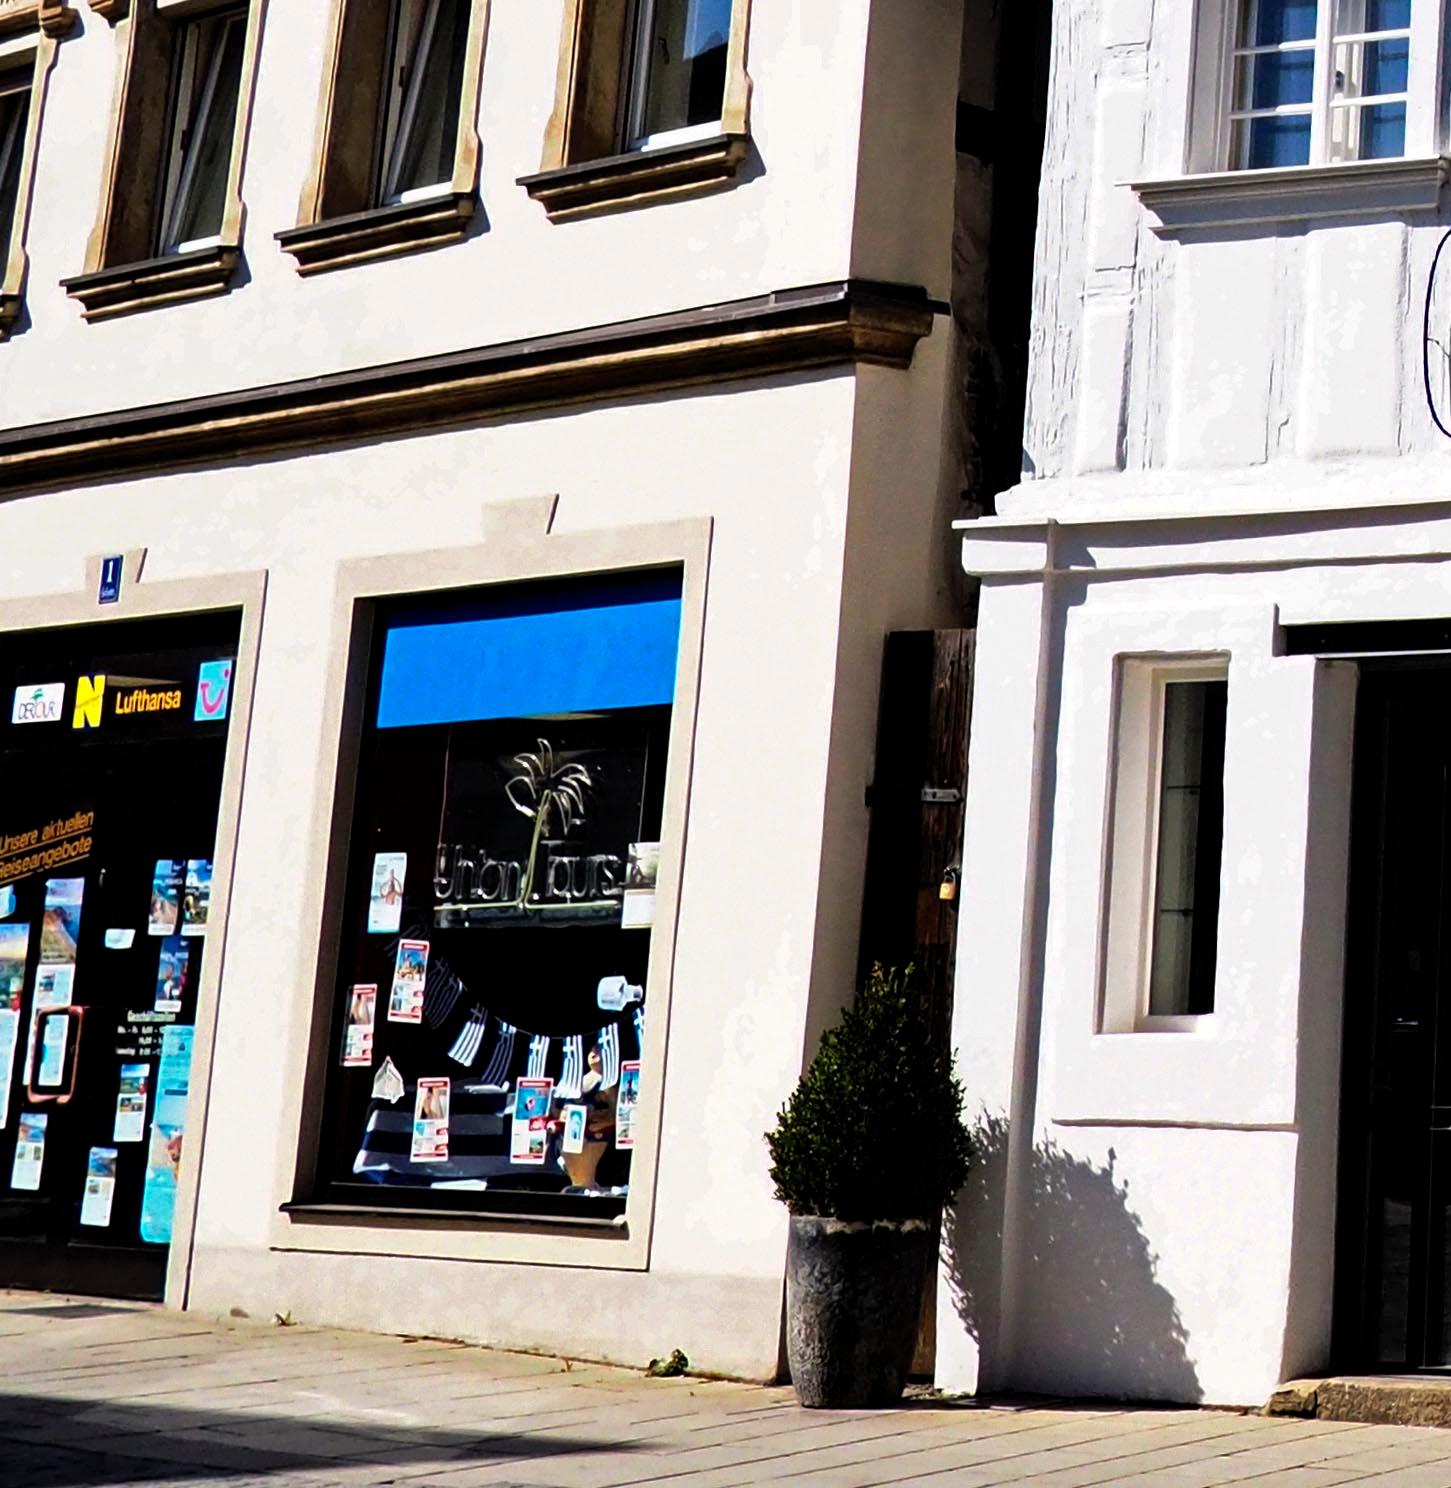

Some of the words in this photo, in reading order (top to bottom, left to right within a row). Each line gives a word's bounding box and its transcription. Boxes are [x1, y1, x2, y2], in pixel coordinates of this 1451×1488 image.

[107, 559, 114, 582] 1
[115, 689, 182, 714] Lufthansa
[0, 829, 38, 853] Unsere
[41, 811, 94, 841] aktuellen
